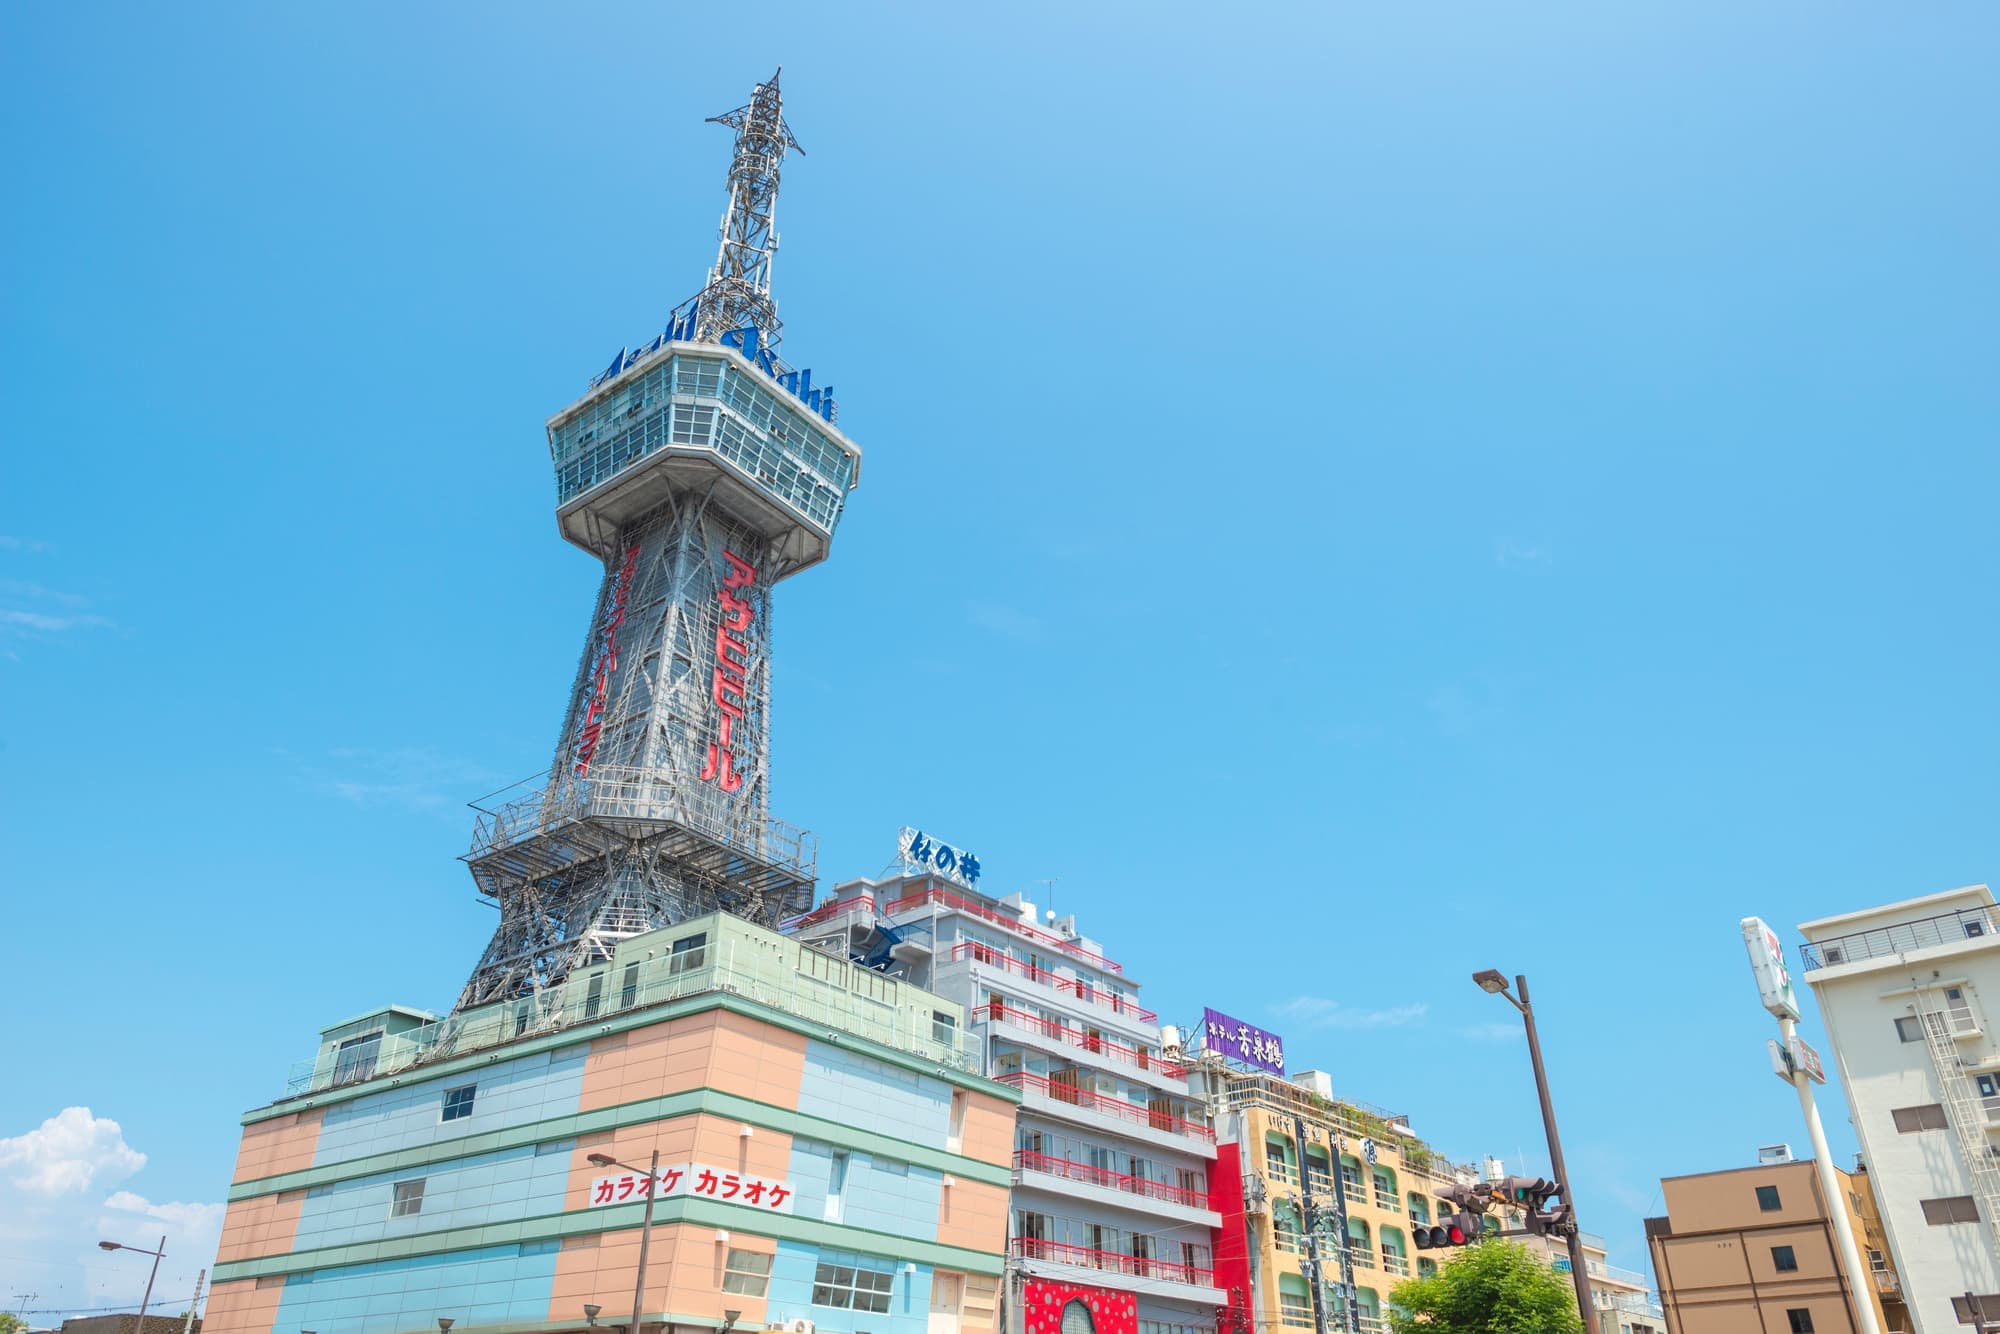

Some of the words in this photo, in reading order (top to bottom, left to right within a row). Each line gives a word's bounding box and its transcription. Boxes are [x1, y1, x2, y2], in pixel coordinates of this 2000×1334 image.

[701, 549, 755, 793] アサヒビール
[594, 1168, 684, 1205] カラオケ
[695, 1168, 792, 1208] カラオケ
